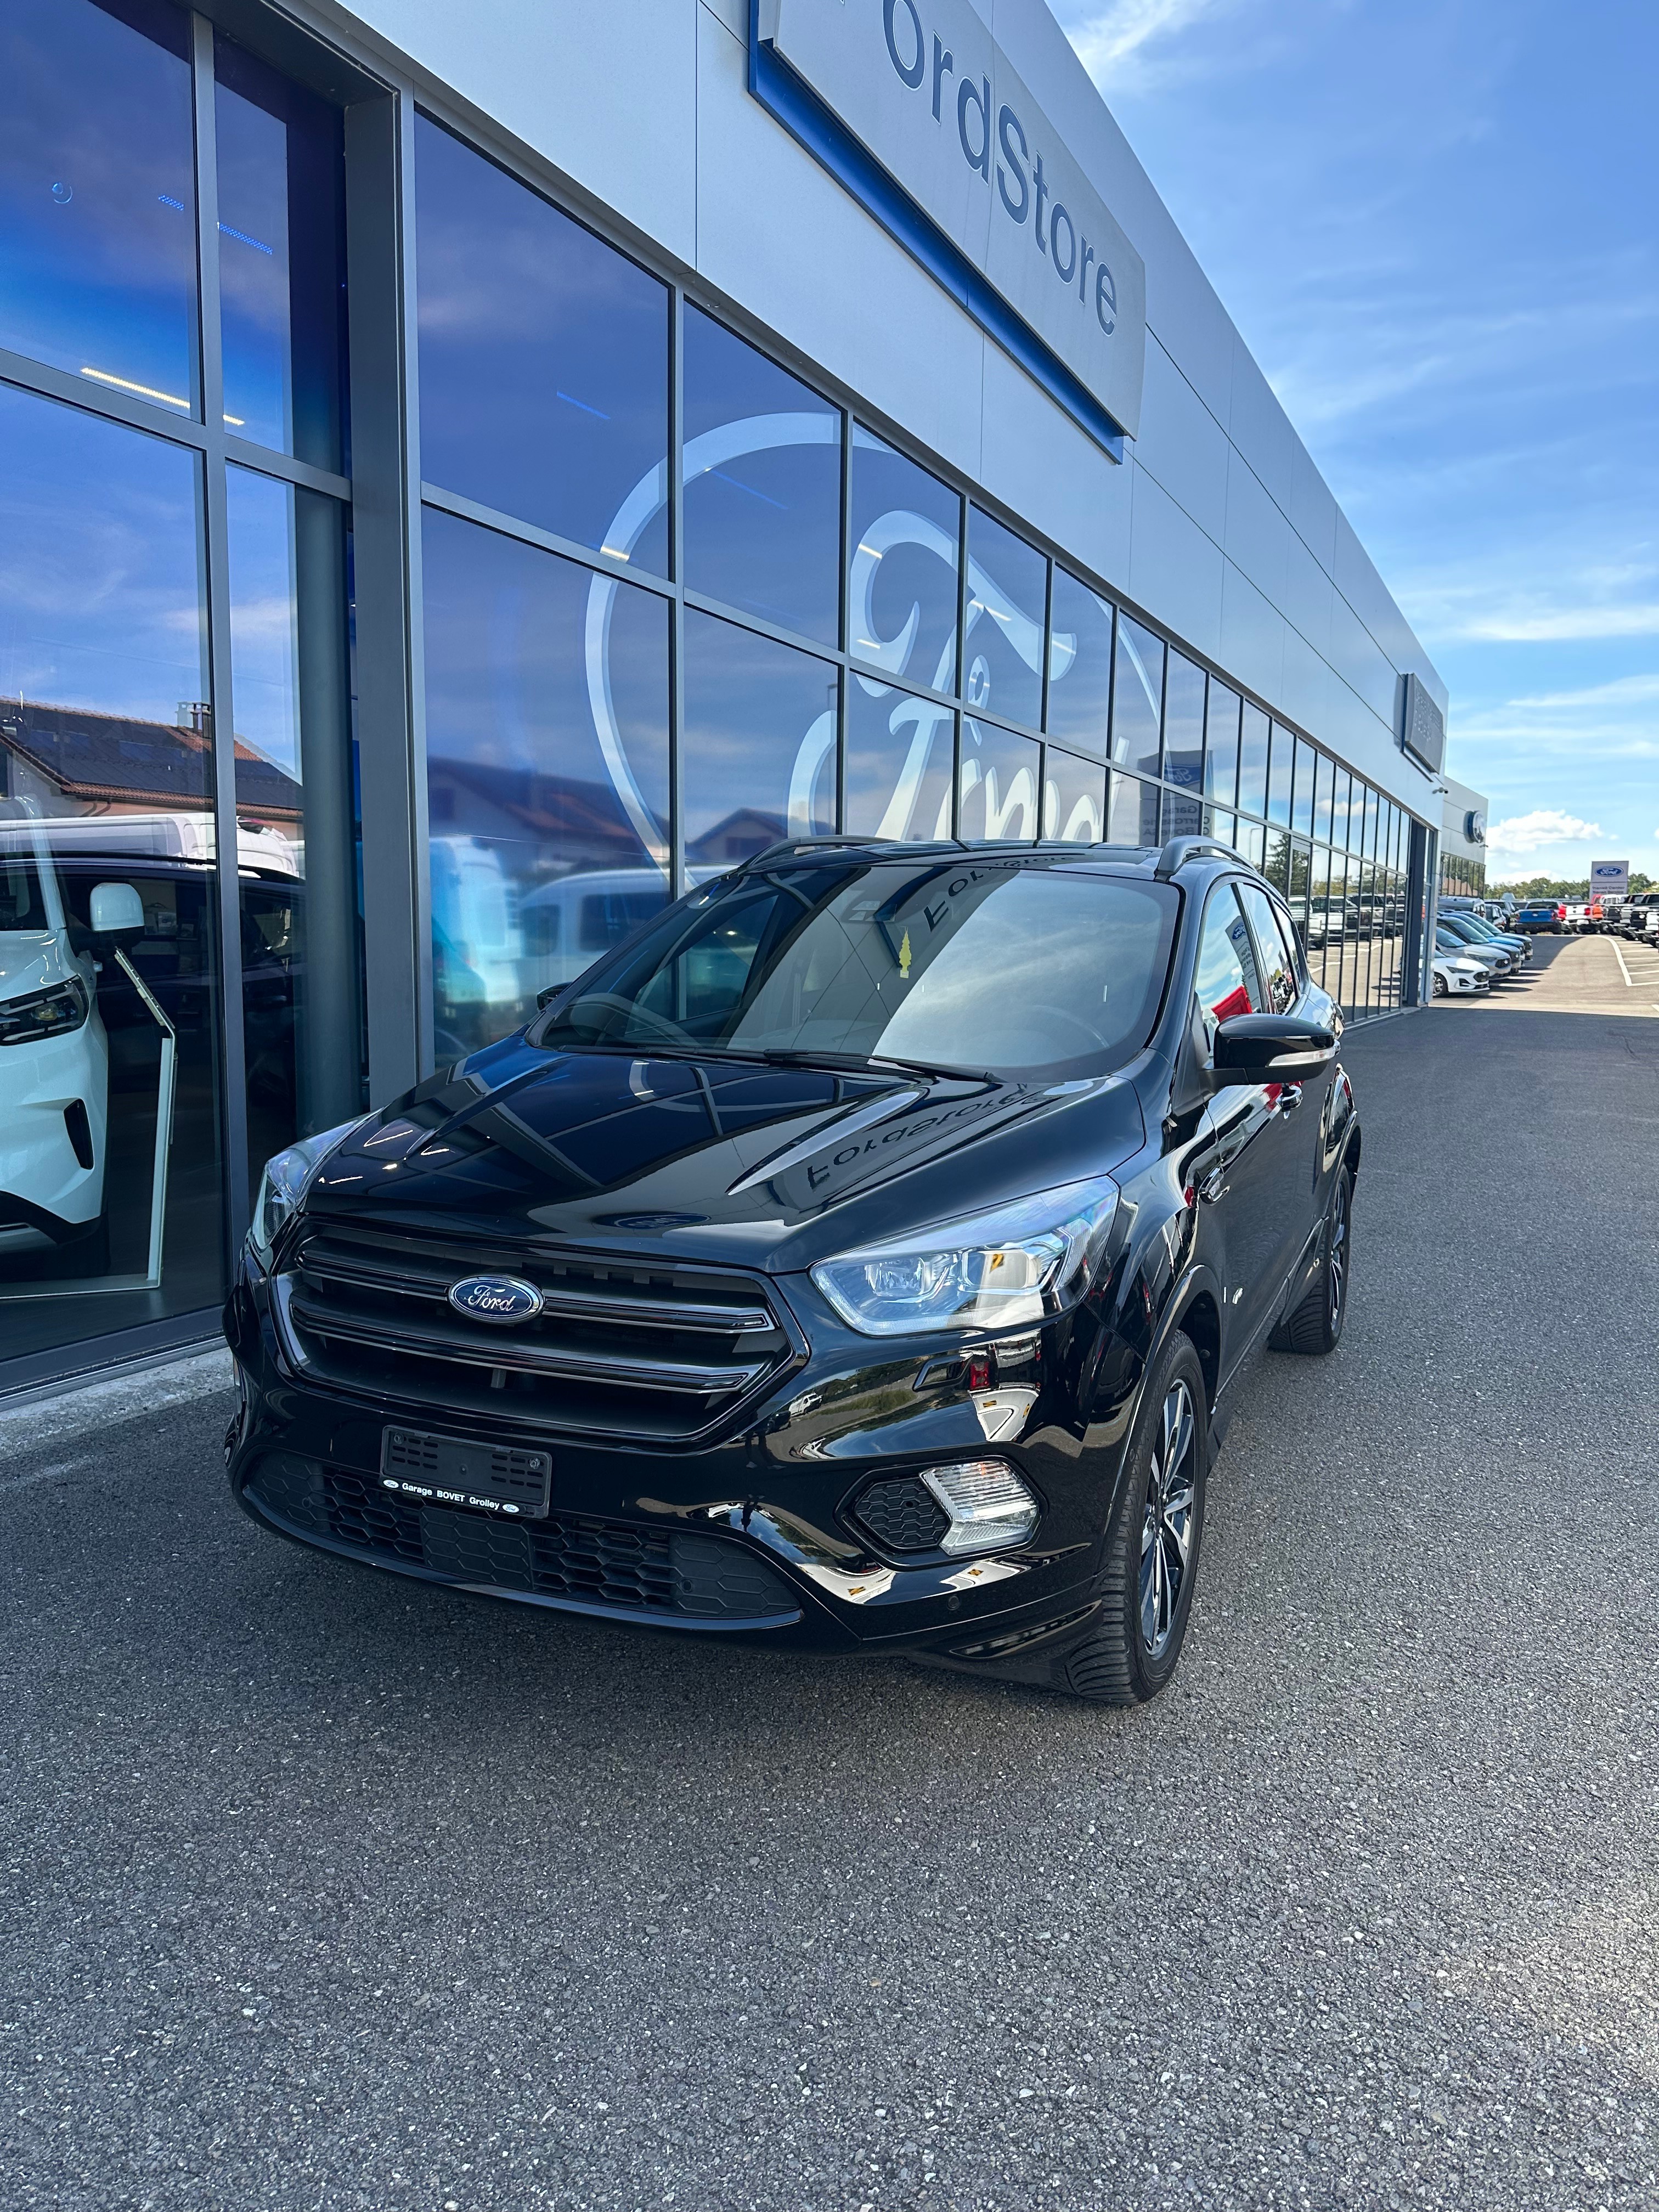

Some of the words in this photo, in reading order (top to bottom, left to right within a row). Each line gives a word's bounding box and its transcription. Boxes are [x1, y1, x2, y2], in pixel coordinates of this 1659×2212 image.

[838, 0, 1118, 337] ordStore
[468, 1285, 516, 1311] Ford
[402, 1482, 433, 1496] Garage
[437, 1489, 465, 1502] BOVET
[469, 1497, 500, 1510] Grolley
